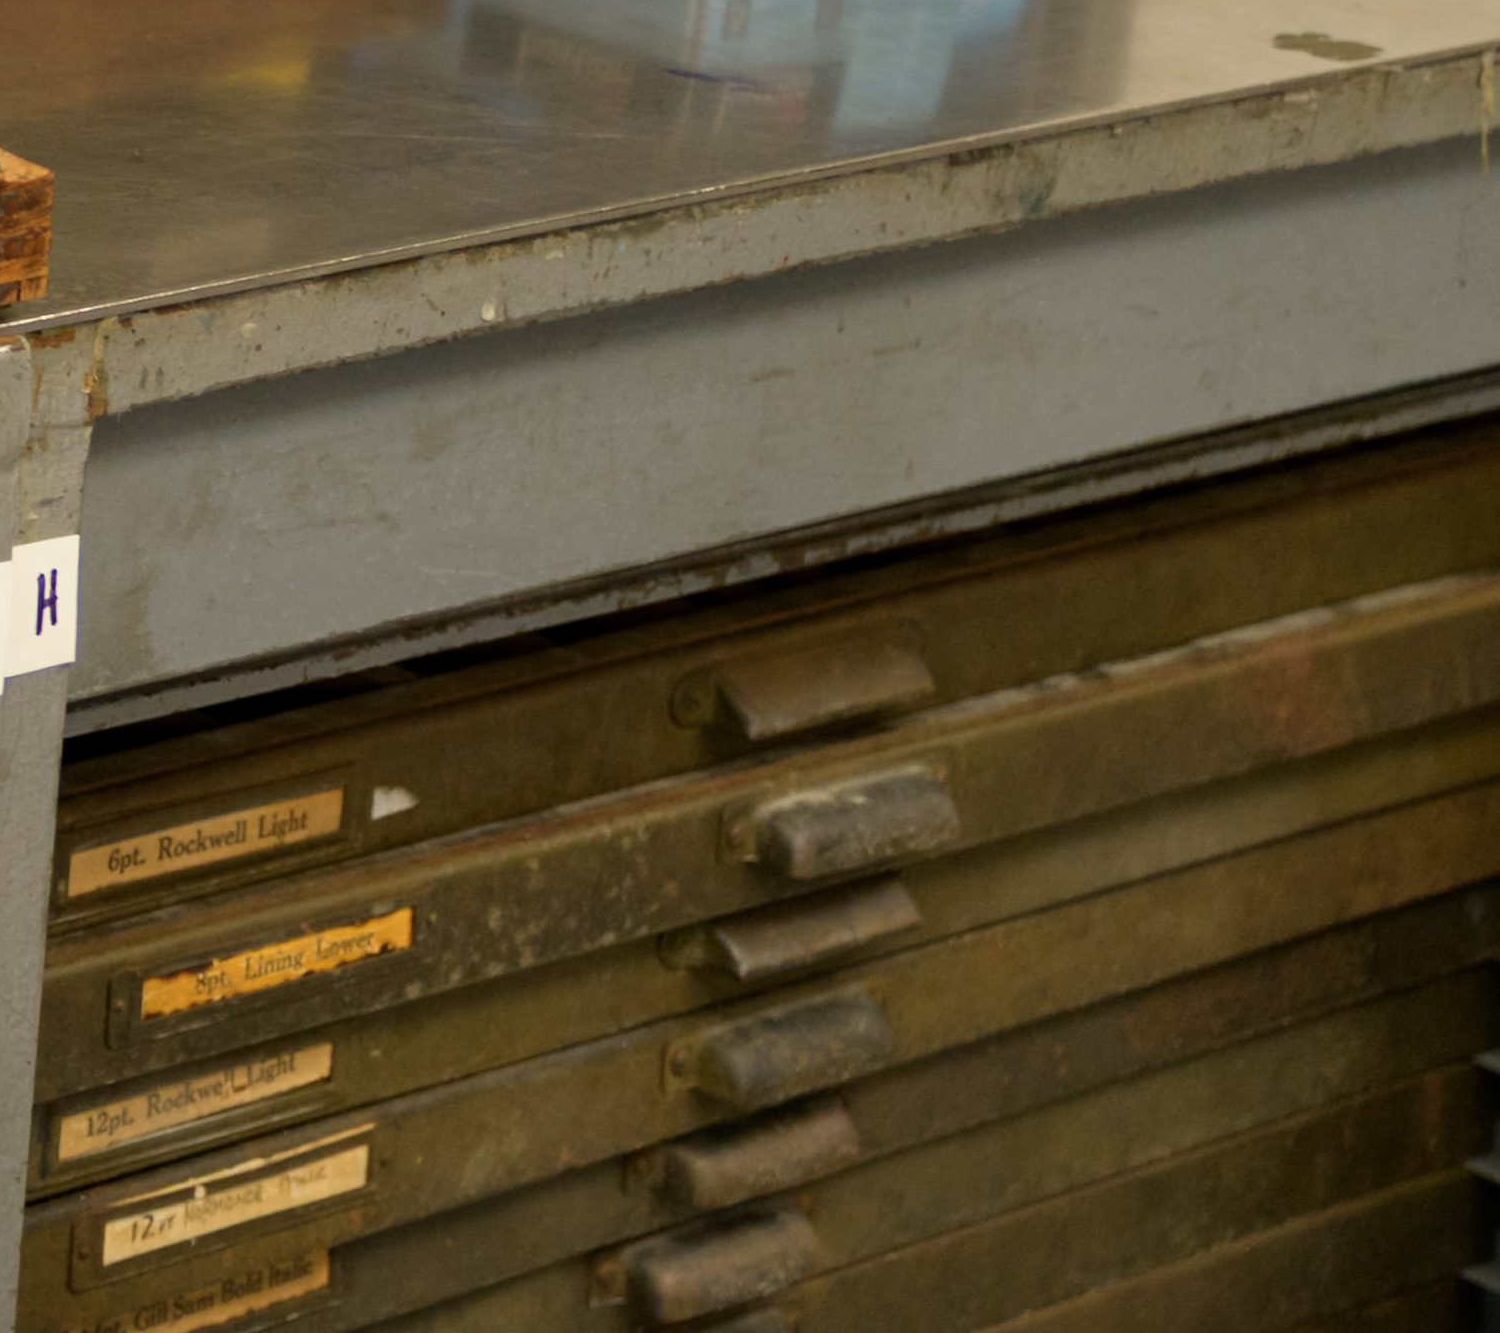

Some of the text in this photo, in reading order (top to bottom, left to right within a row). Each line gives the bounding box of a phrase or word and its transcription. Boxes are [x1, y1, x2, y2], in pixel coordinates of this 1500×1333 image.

[35, 568, 58, 636] H
[107, 808, 309, 875] 6pt. Rockwell Light
[194, 929, 377, 997] 8pt. Lining Lower
[85, 1111, 134, 1139] 12pt.
